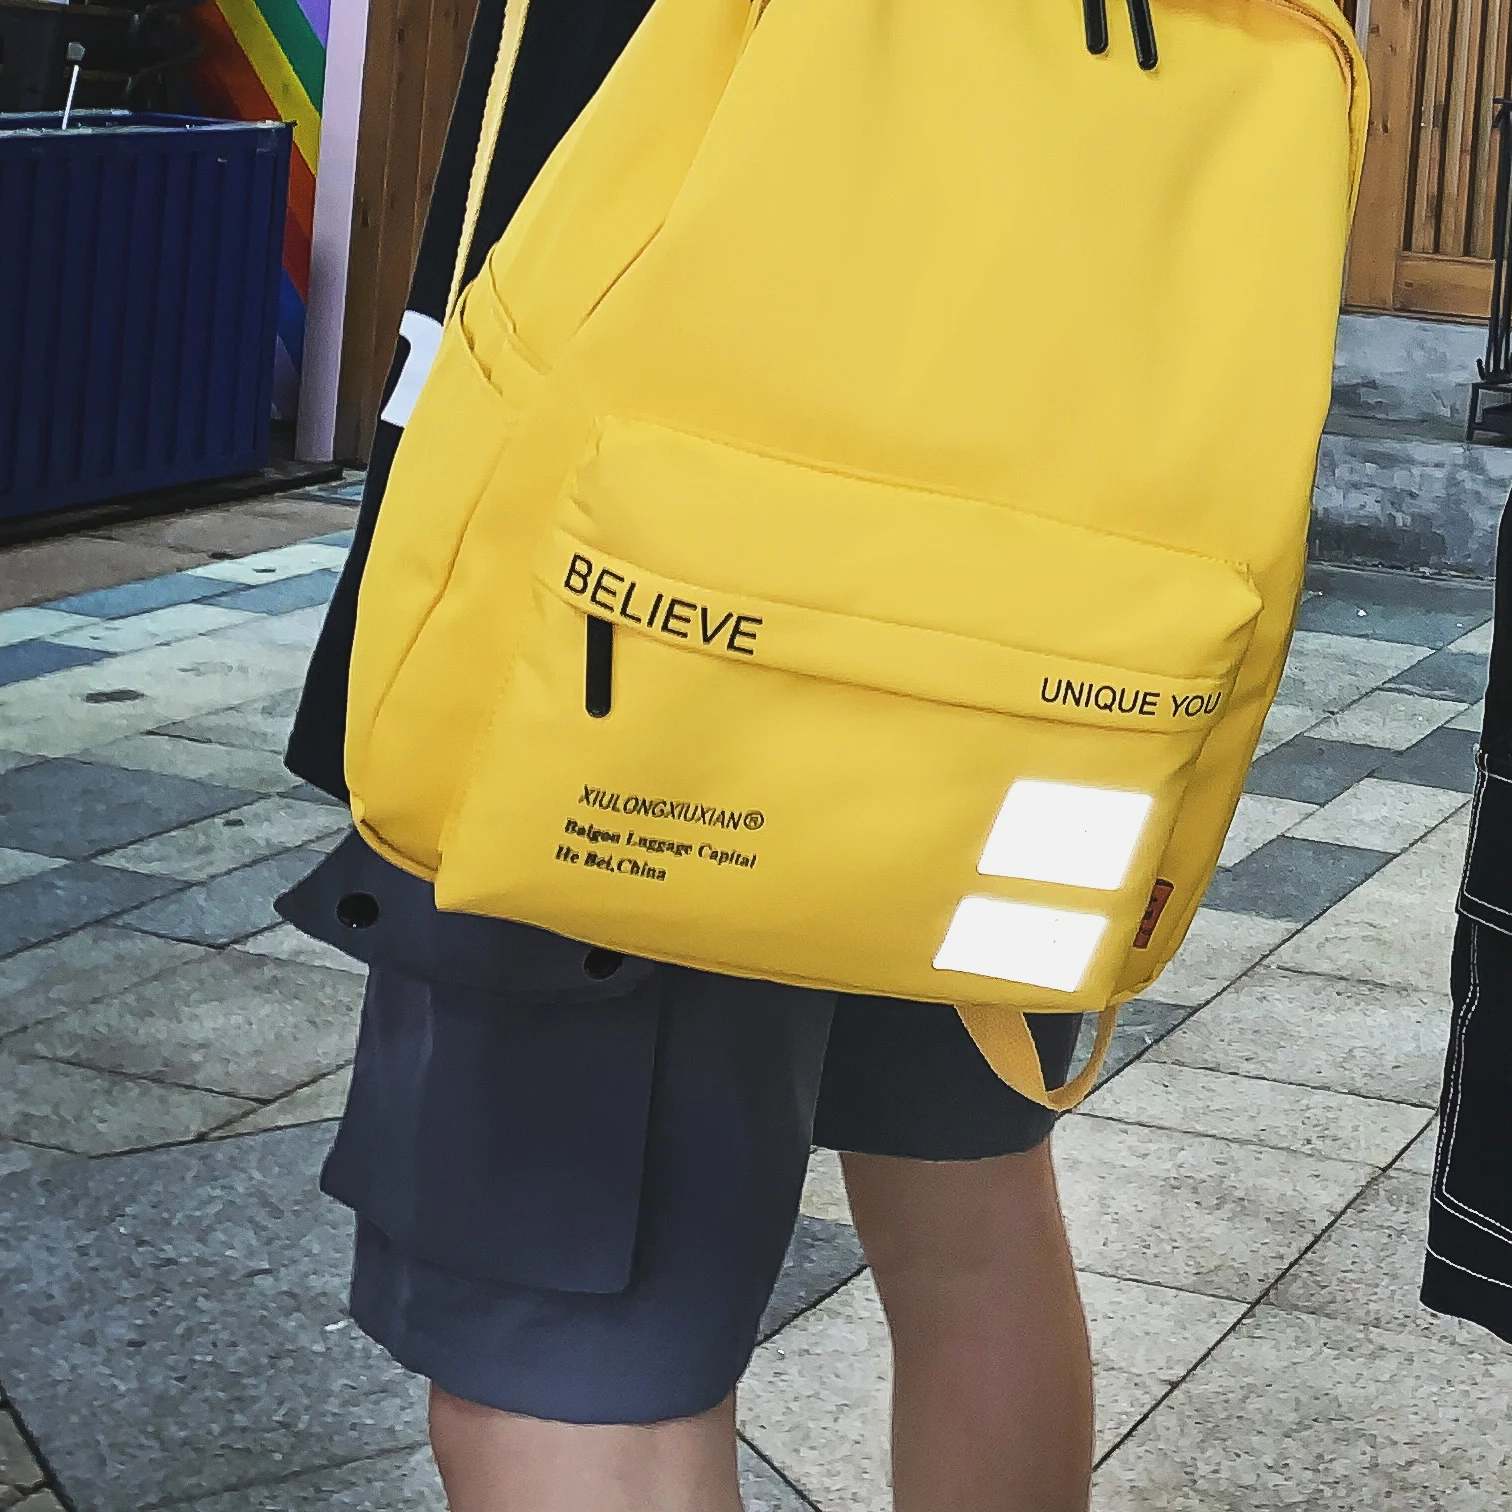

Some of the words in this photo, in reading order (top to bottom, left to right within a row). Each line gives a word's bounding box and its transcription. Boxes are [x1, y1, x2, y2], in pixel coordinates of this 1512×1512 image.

[564, 551, 763, 656] BELIEVE
[1041, 676, 1161, 715] UNIQUE
[1171, 691, 1222, 718] YOU
[555, 844, 580, 865] He
[698, 842, 757, 869] Capital
